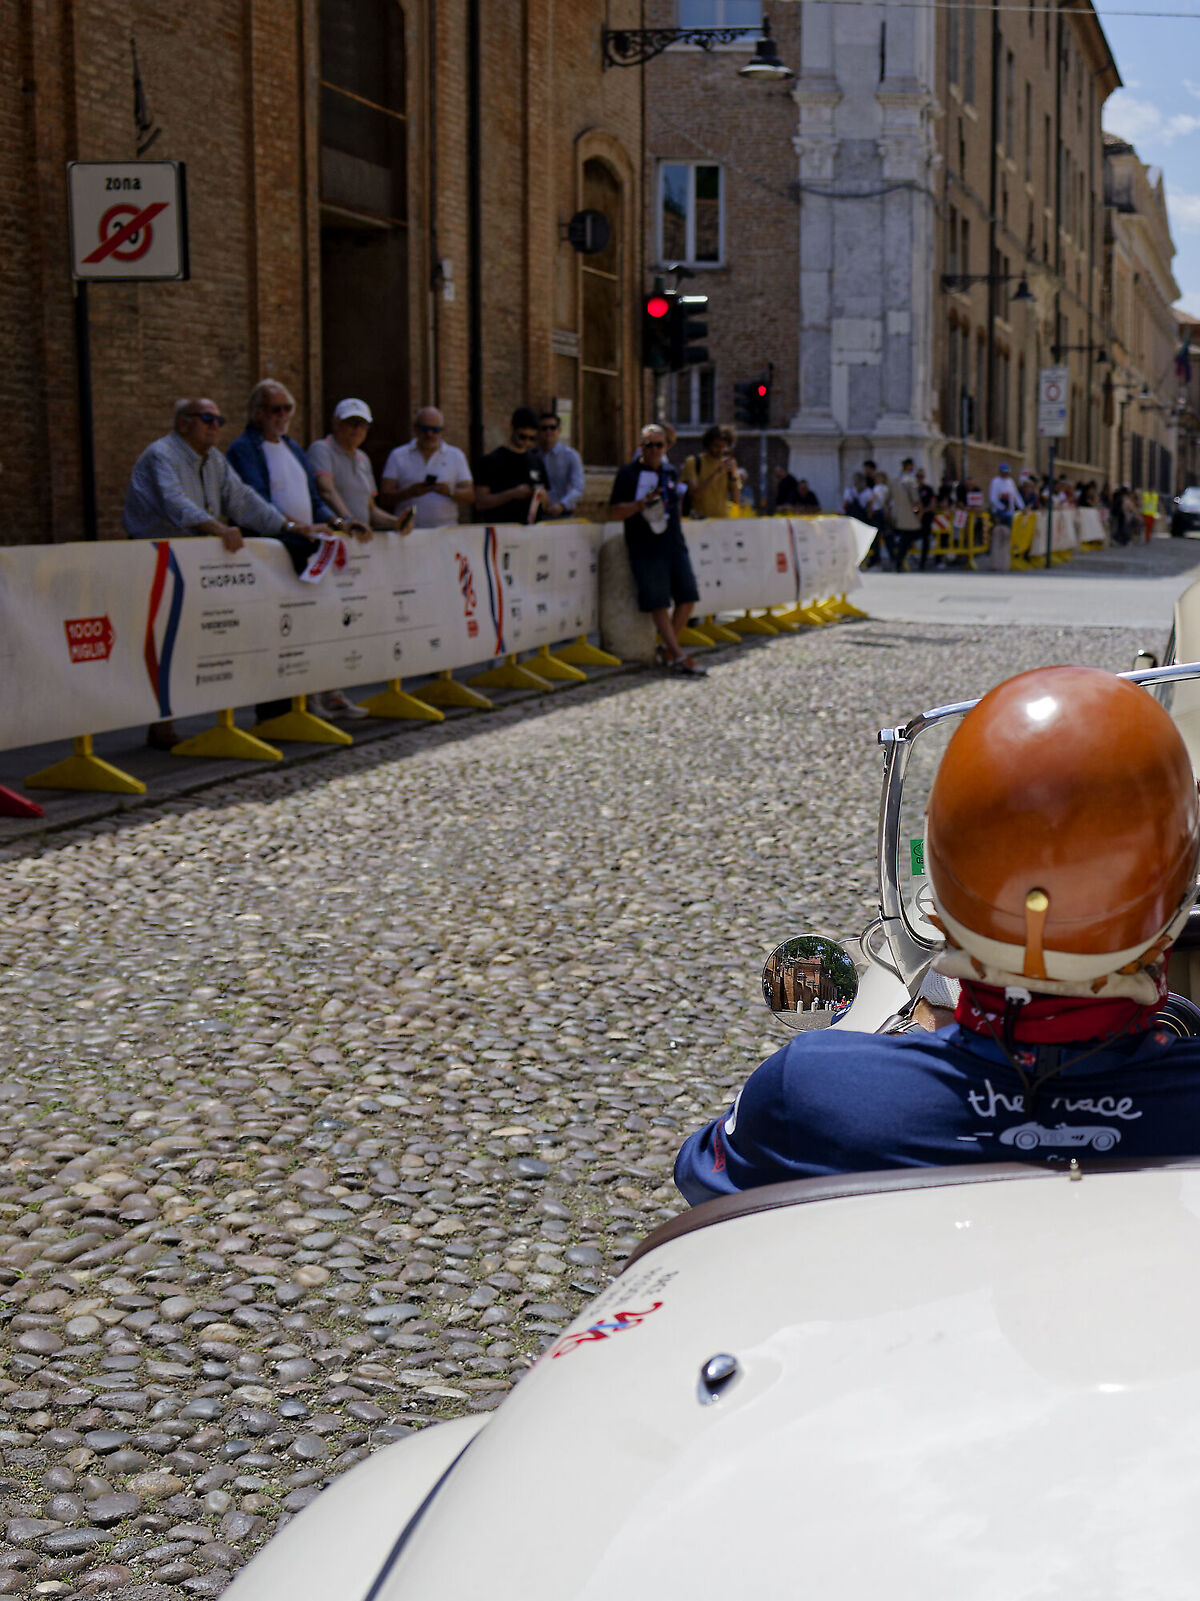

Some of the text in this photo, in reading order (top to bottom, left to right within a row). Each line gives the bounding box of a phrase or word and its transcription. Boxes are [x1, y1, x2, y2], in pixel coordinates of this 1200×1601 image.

[105, 177, 142, 191] zona
[69, 621, 103, 639] 1000
[71, 641, 106, 660] MIGLIA
[968, 1079, 1143, 1120] the race
